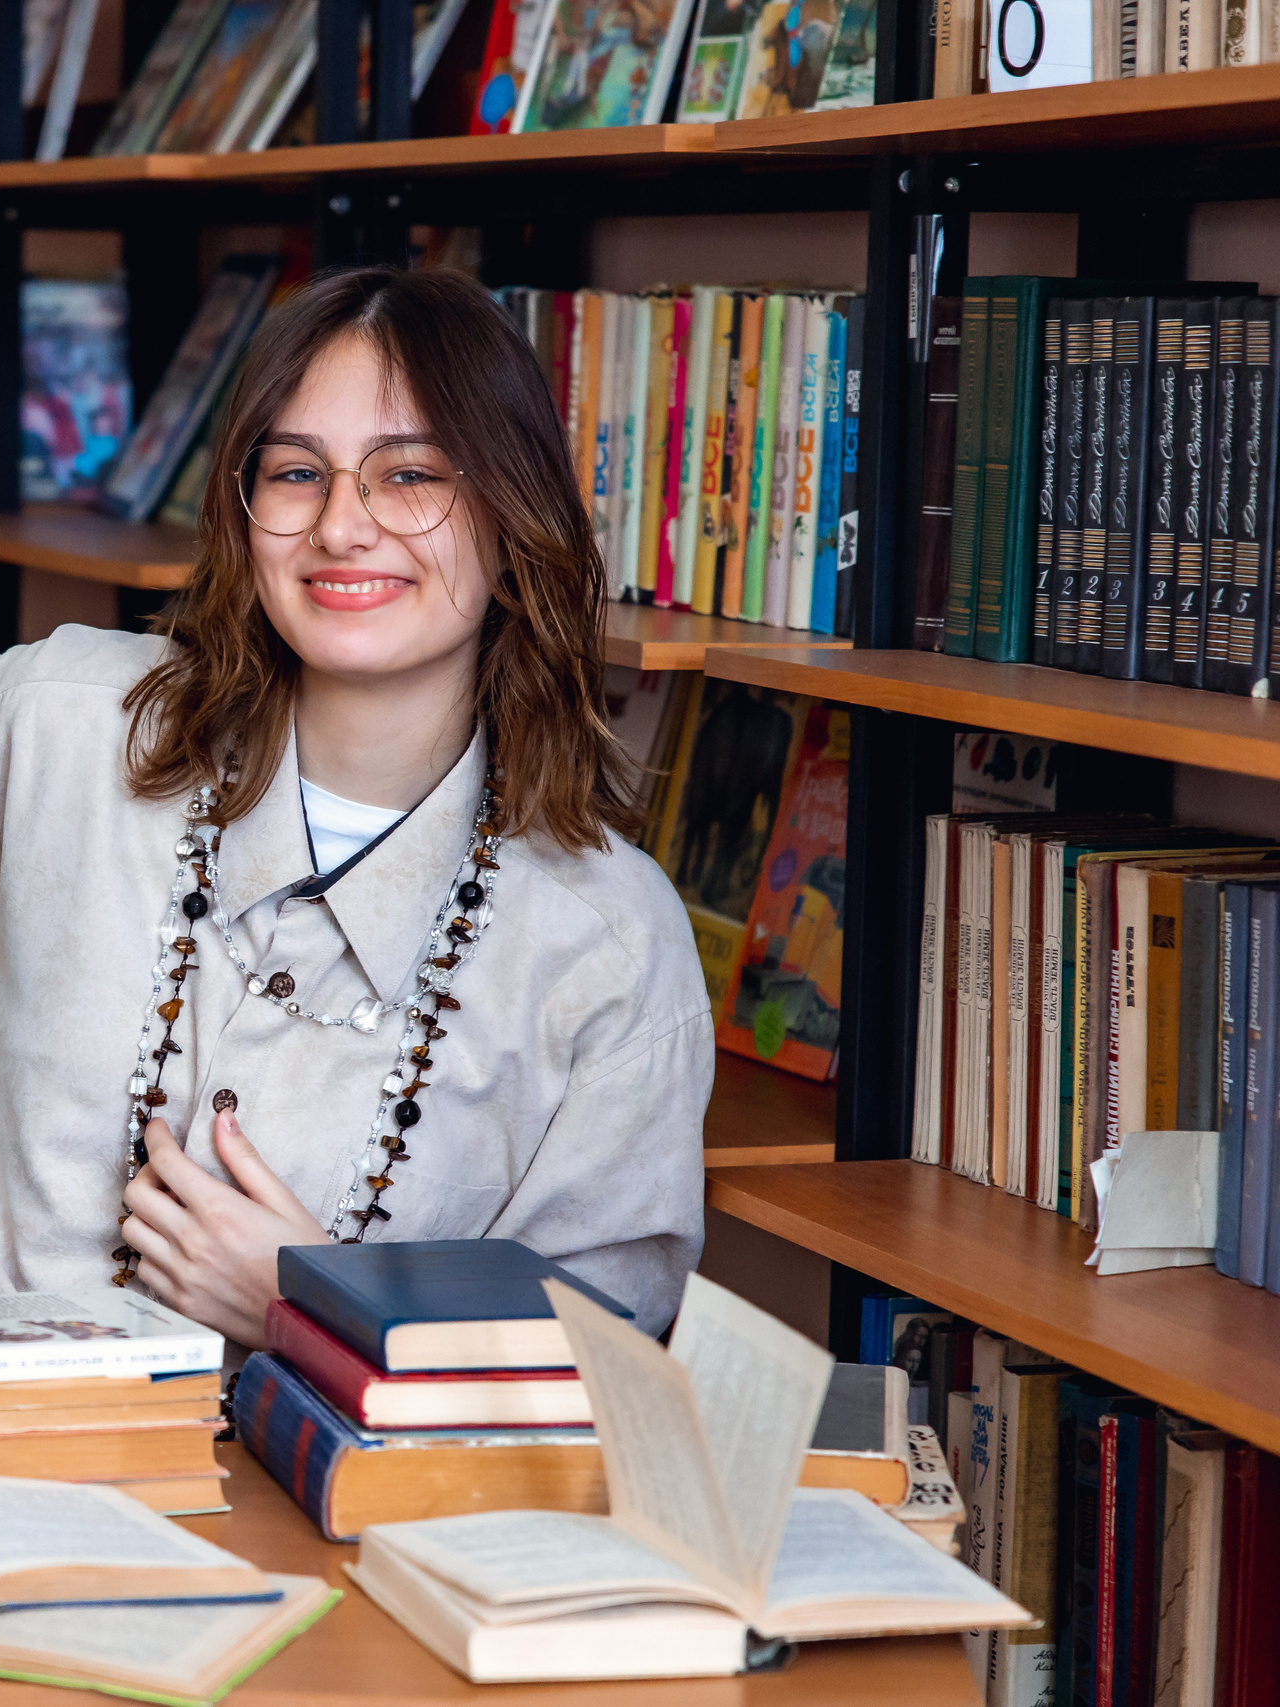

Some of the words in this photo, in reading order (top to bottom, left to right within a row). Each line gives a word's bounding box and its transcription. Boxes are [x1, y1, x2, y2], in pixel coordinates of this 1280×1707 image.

[1179, 7, 1190, 70] АВЕЛ
[844, 418, 860, 473] ВСЕ
[1037, 570, 1050, 589] 1
[1062, 576, 1074, 595] 2
[1086, 575, 1099, 595] 2
[1110, 579, 1122, 599] 3
[1153, 580, 1166, 601] 3
[1211, 587, 1224, 609] 4
[1180, 591, 1194, 612] 4
[1237, 592, 1250, 613] 5
[998, 1412, 1009, 1500] РОЖДЕНИЕ
